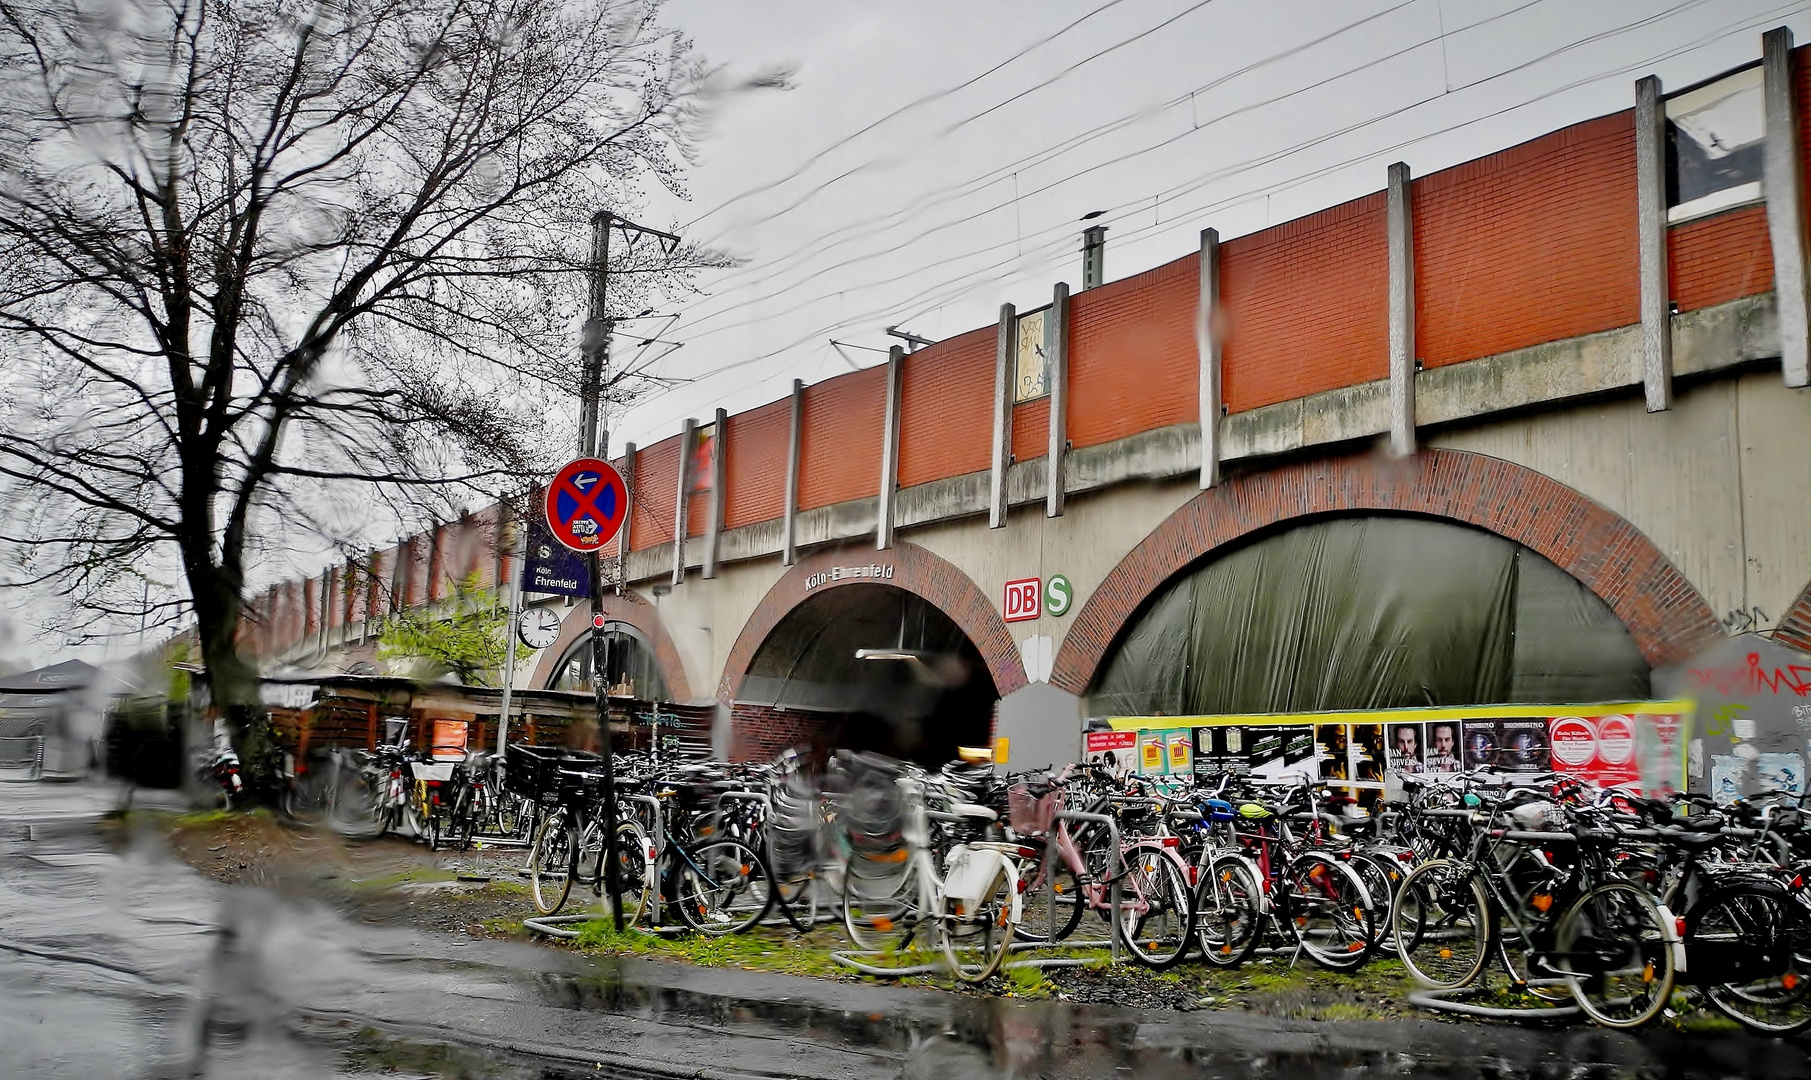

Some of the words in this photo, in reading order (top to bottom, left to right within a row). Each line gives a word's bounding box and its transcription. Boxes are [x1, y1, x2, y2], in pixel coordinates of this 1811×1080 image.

[536, 566, 552, 575] Köln
[534, 575, 578, 590] Ehrenfeld
[1008, 585, 1036, 615] DB
[1048, 577, 1067, 613] S
